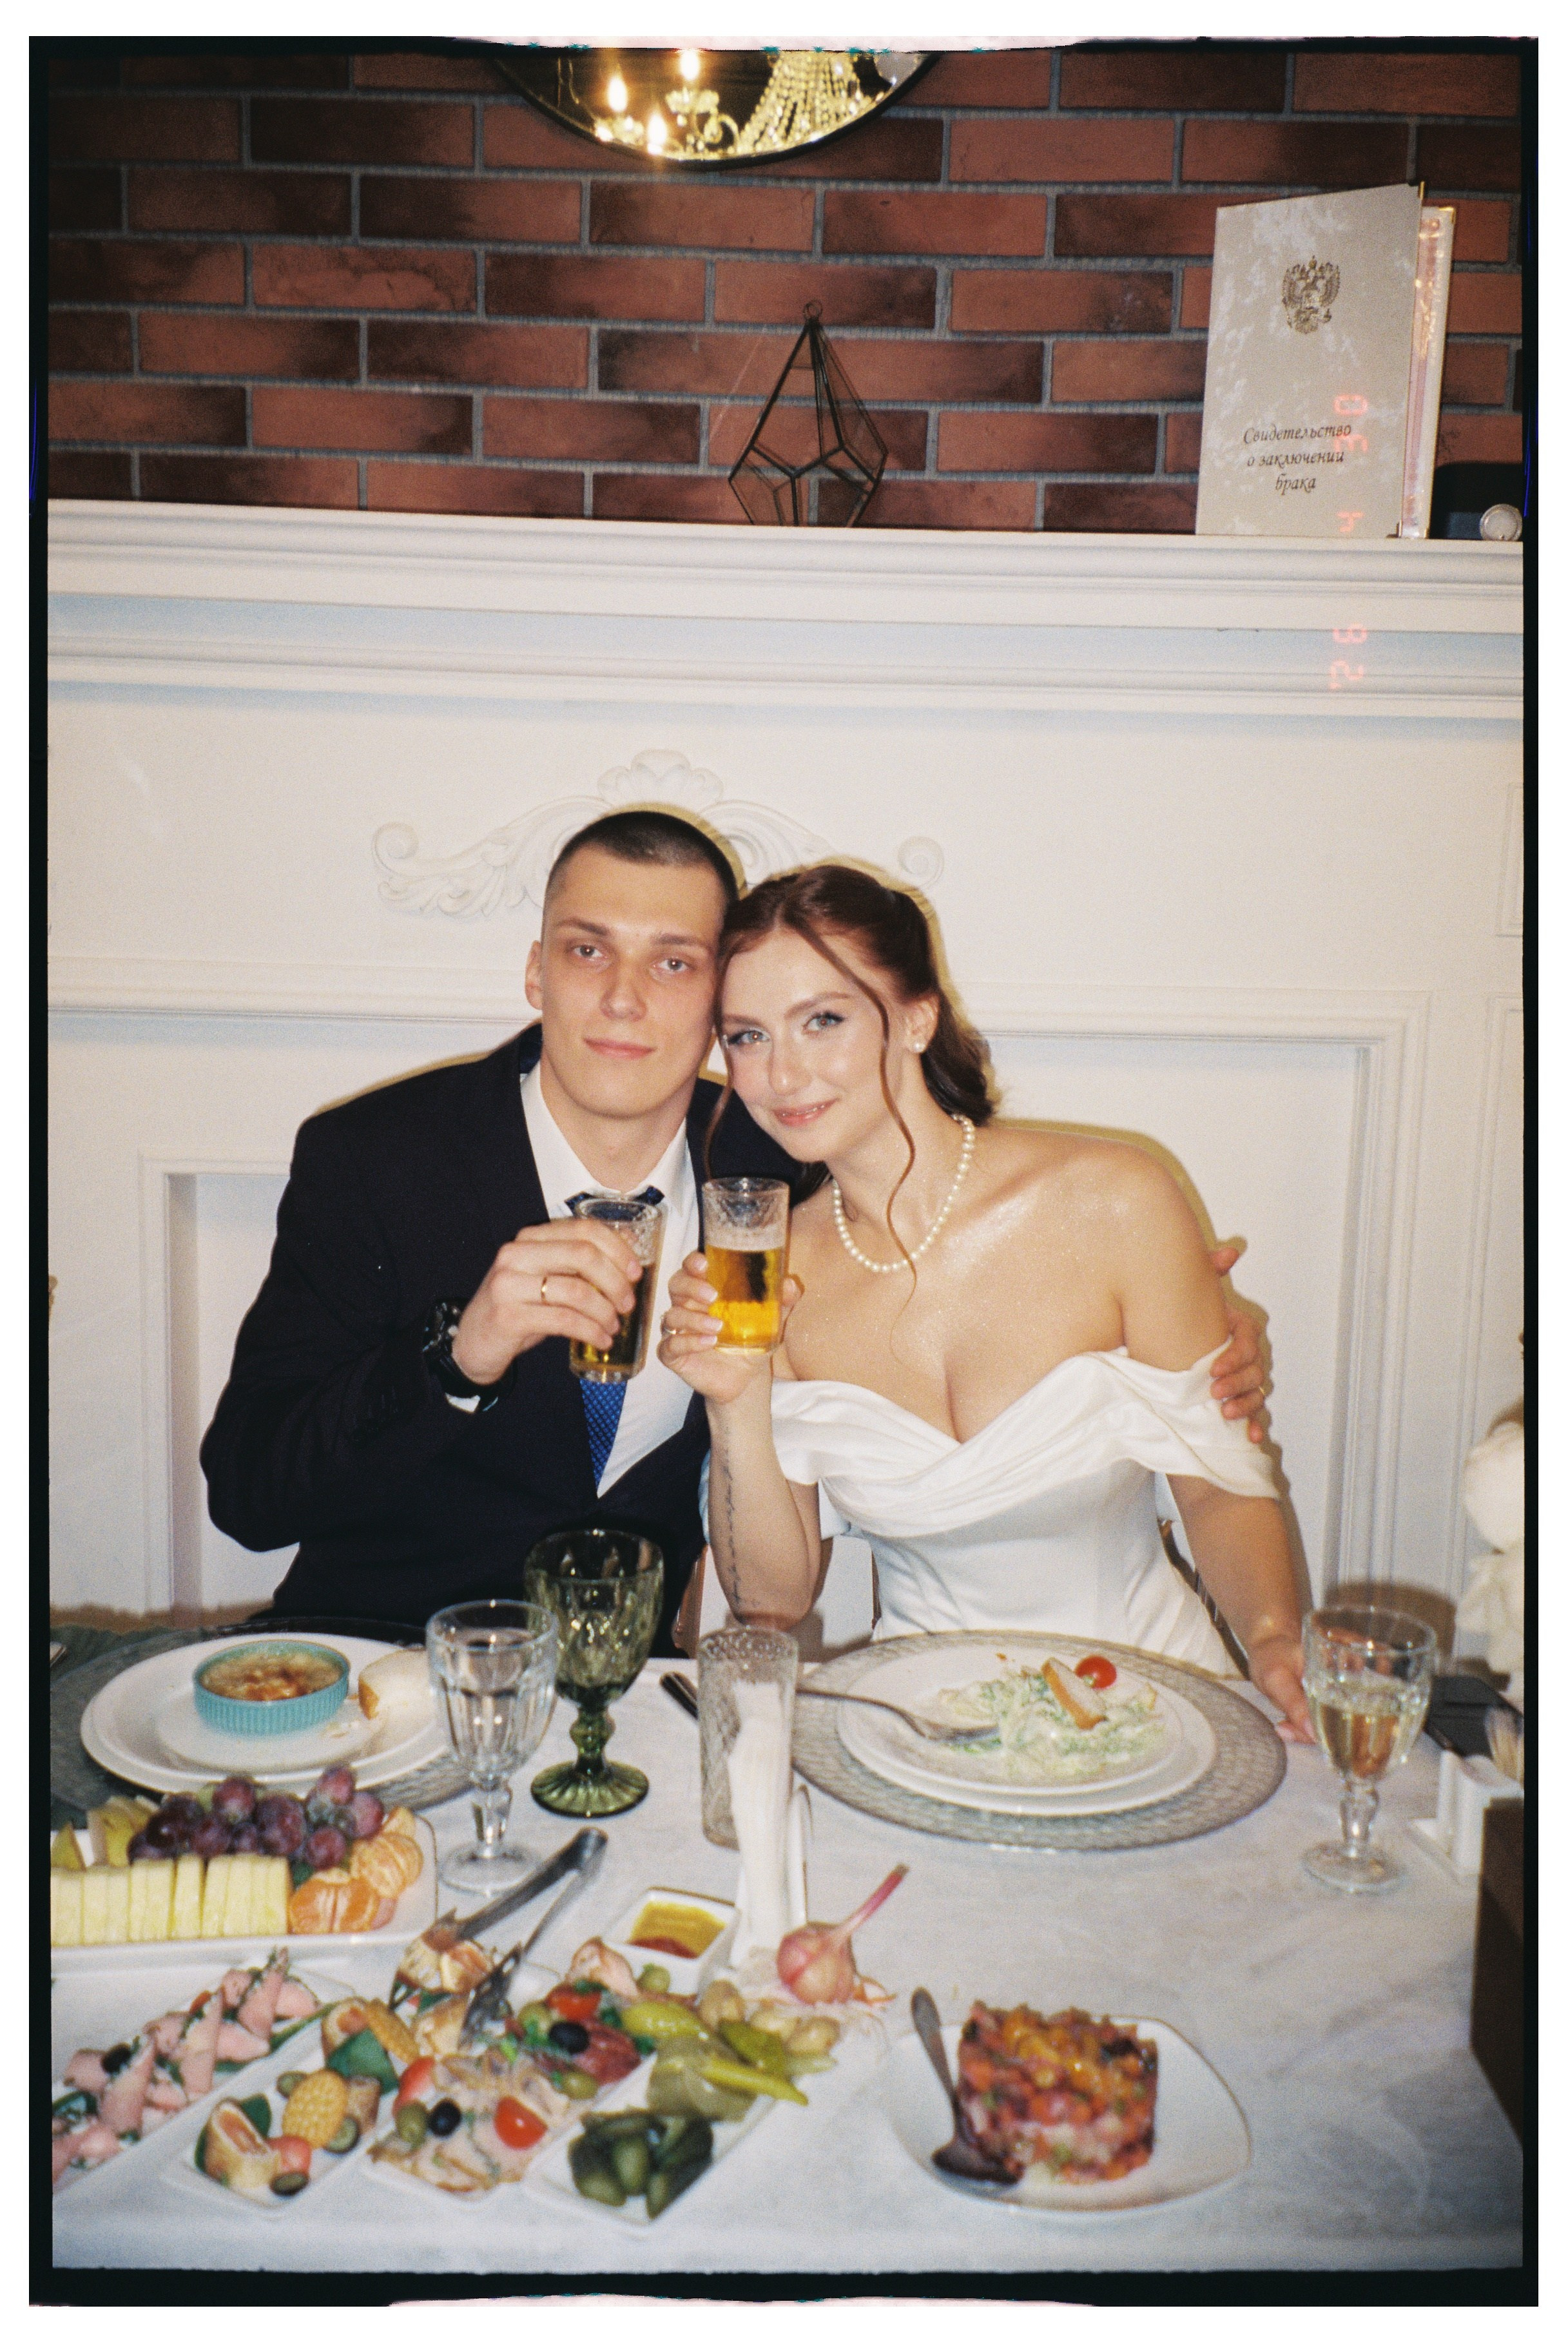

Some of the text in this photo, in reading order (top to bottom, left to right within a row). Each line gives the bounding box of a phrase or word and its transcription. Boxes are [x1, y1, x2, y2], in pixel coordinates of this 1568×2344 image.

[1243, 423, 1351, 444] Свидетельство
[1247, 450, 1345, 469] о заключении
[1275, 472, 1317, 495] брака
